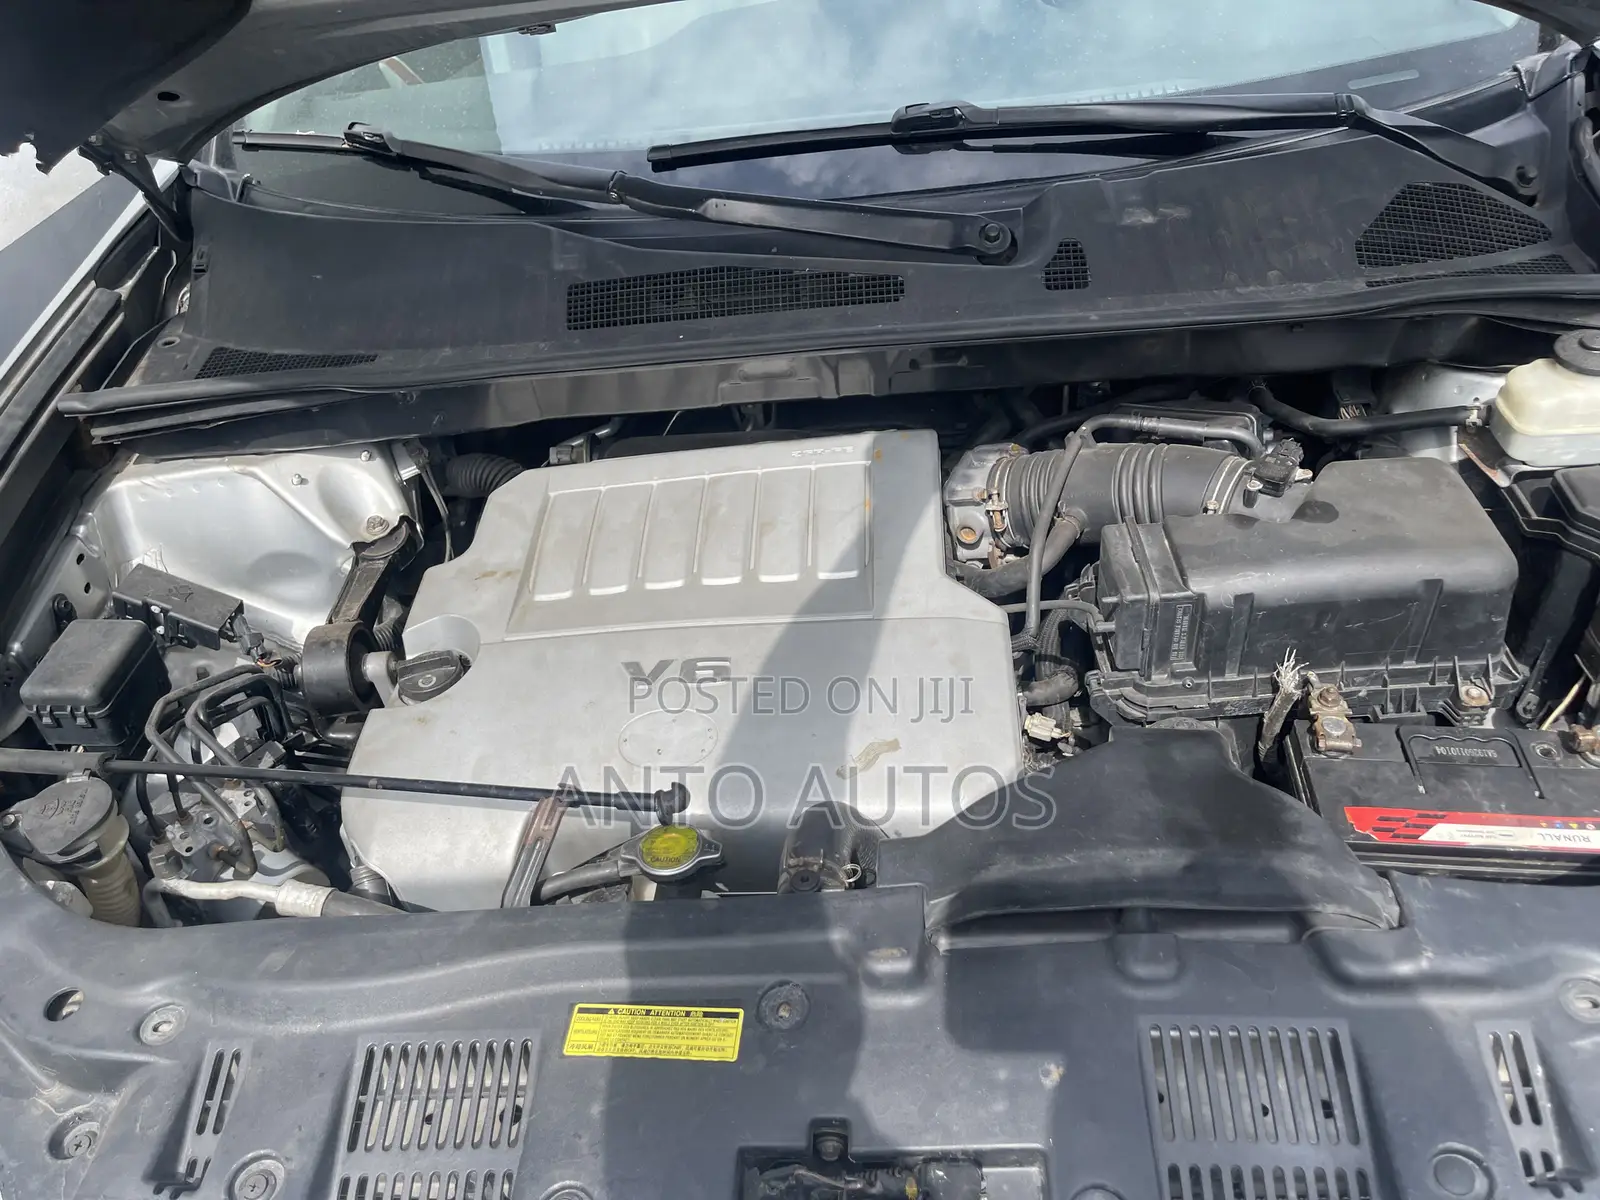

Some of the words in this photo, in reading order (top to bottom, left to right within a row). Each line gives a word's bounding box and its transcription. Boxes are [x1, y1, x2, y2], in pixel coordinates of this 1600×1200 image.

[620, 656, 731, 687] V6
[1539, 831, 1592, 843] RUNALL
[617, 1008, 646, 1016] CAUTION
[650, 1009, 686, 1017] ATTENTION
